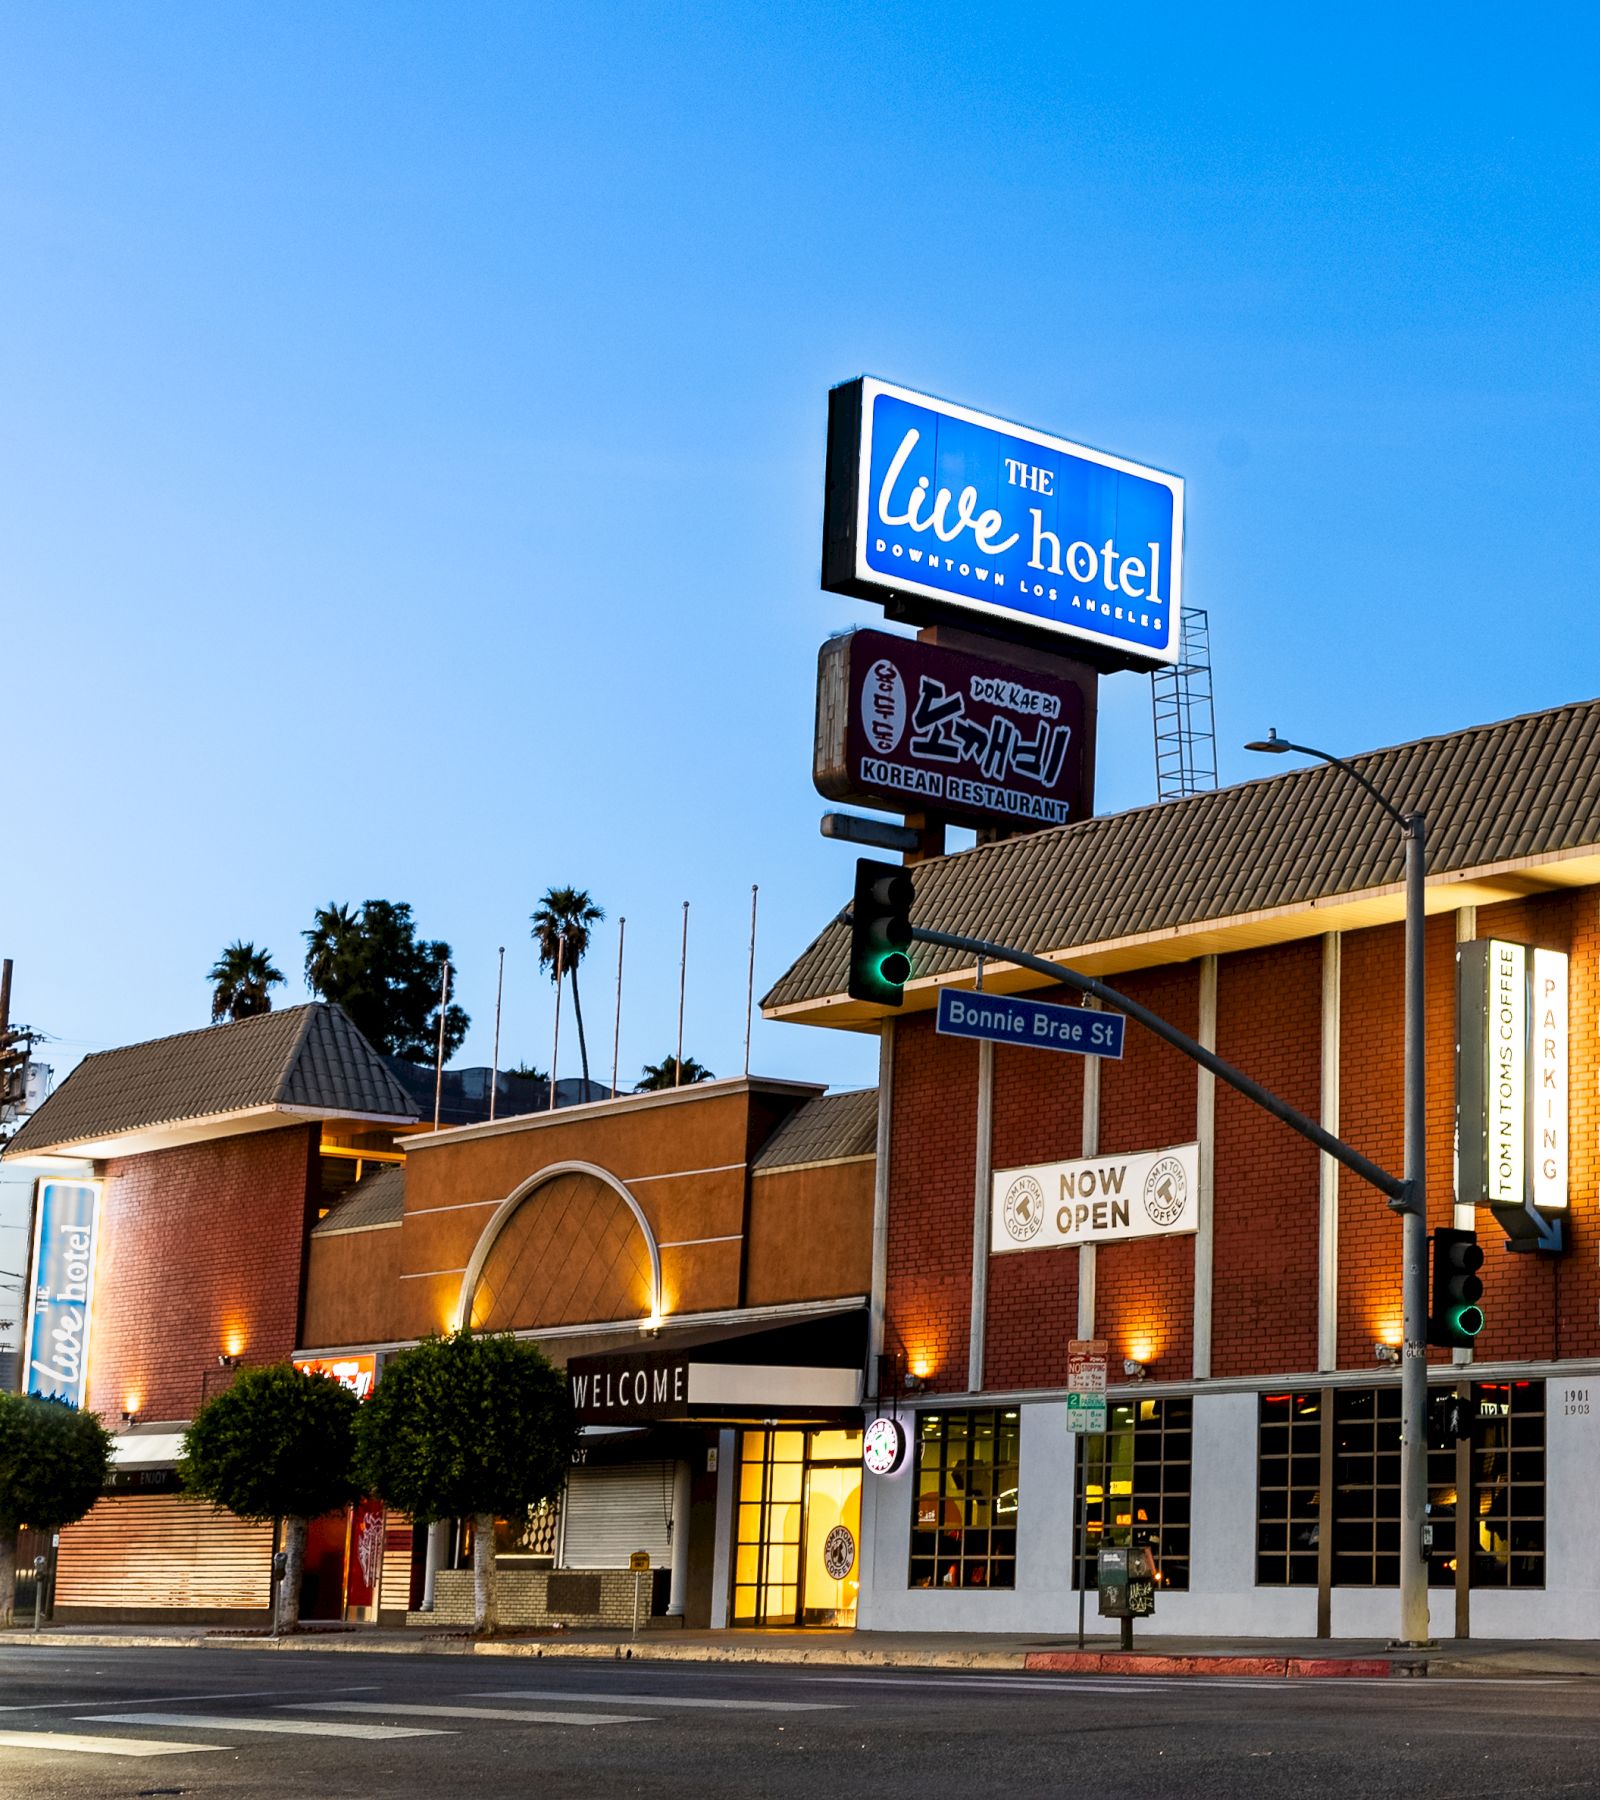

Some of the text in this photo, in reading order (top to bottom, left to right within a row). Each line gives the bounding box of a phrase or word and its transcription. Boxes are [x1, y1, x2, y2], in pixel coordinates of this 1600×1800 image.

[1004, 457, 1055, 497] THE
[1027, 507, 1163, 604] hotel
[875, 538, 1163, 631] DOWNTOWN LOS ANGELES
[861, 757, 1069, 823] KOREAN RESTAURANT
[1499, 948, 1514, 1041] COFFEE
[949, 1000, 1115, 1047] Bonnie Brae St
[1542, 978, 1557, 1181] PARKING
[1059, 1165, 1128, 1201] NOW
[1007, 1215, 1040, 1238] COFFEE
[1056, 1199, 1131, 1235] OPEN
[1148, 1197, 1183, 1222] COFFEE
[56, 1223, 92, 1303] hotel
[36, 1285, 50, 1315] THE
[1069, 1363, 1081, 1373] NO
[572, 1367, 683, 1409] WELCOME
[1070, 1395, 1078, 1405] 2
[1564, 1389, 1589, 1402] 1901
[1564, 1404, 1590, 1416] 1903
[826, 1560, 851, 1577] COFFEE
